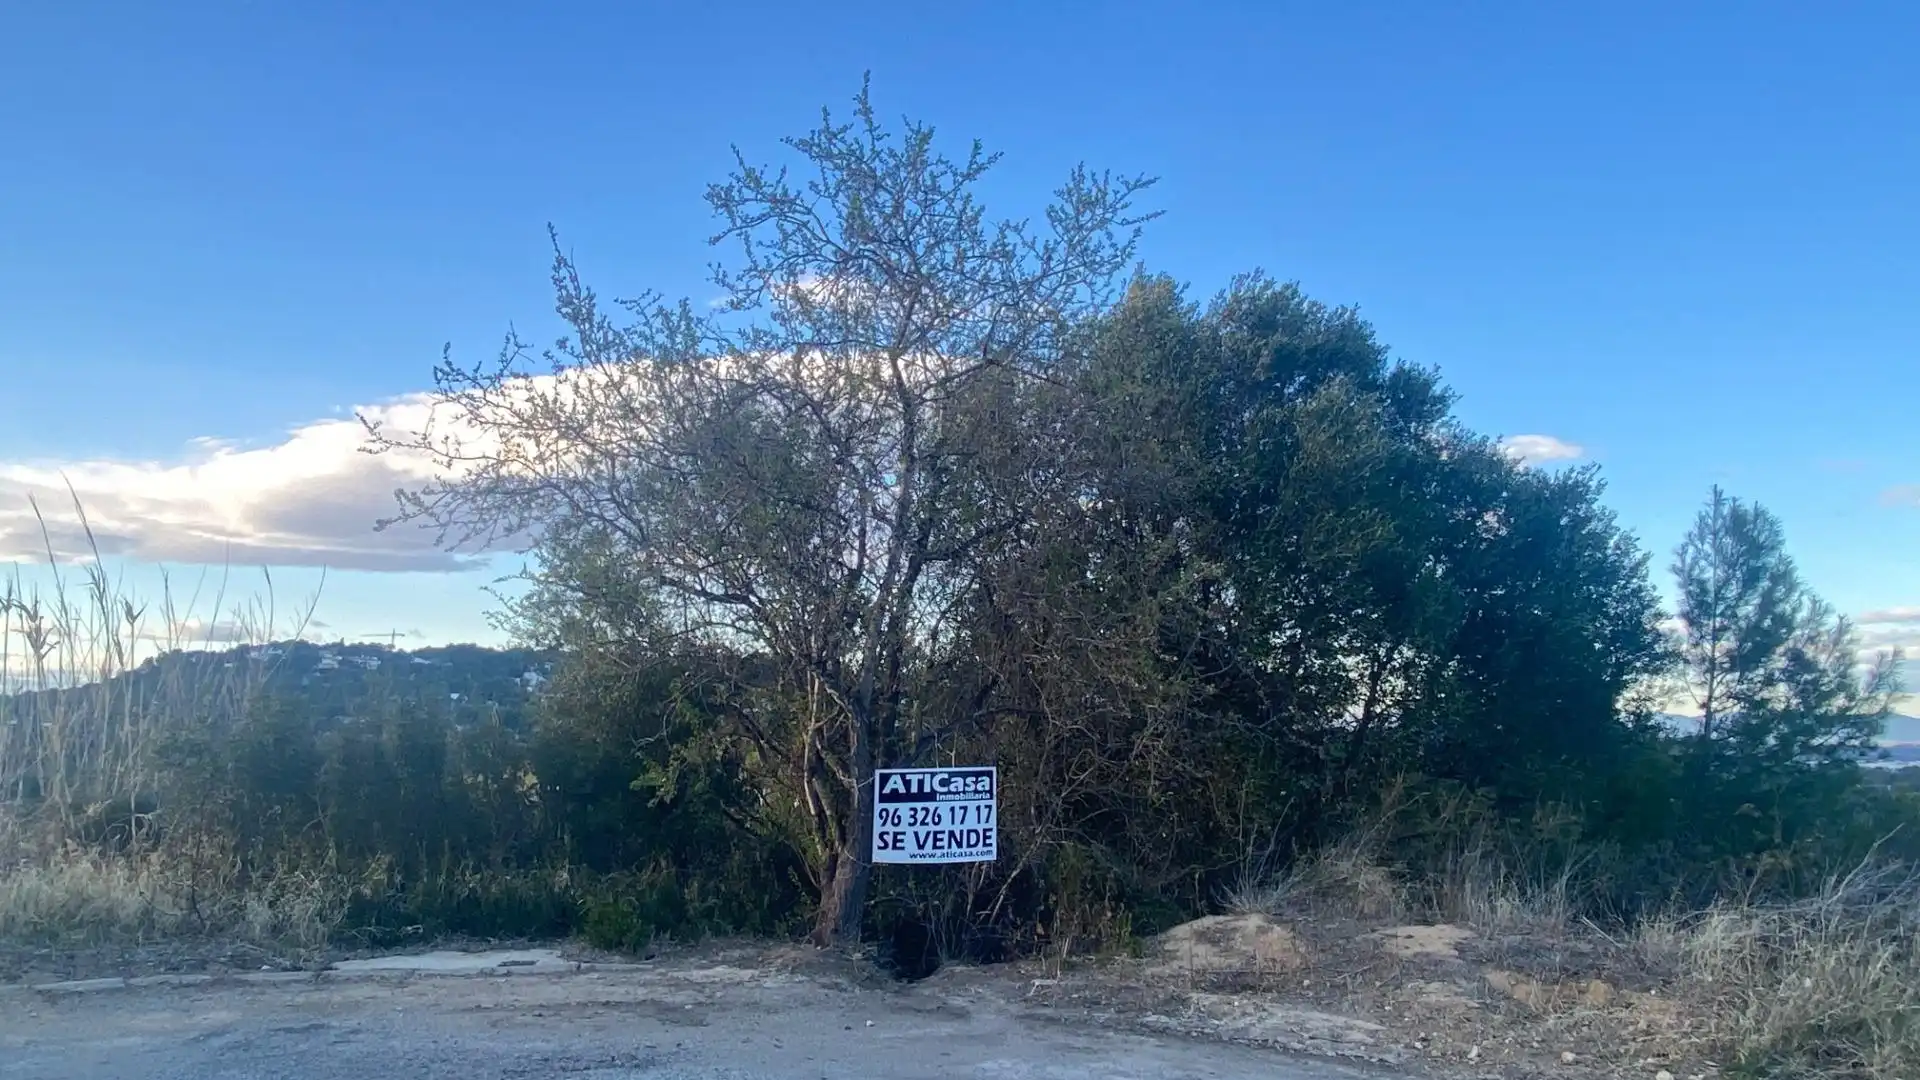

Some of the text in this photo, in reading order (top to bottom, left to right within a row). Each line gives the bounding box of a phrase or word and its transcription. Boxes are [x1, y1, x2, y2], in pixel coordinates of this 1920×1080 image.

[882, 773, 990, 794] ATICasa
[879, 804, 993, 827] 96 326 17 17
[877, 828, 993, 851] SE VENDE
[909, 849, 993, 859] www.aticasa.com
